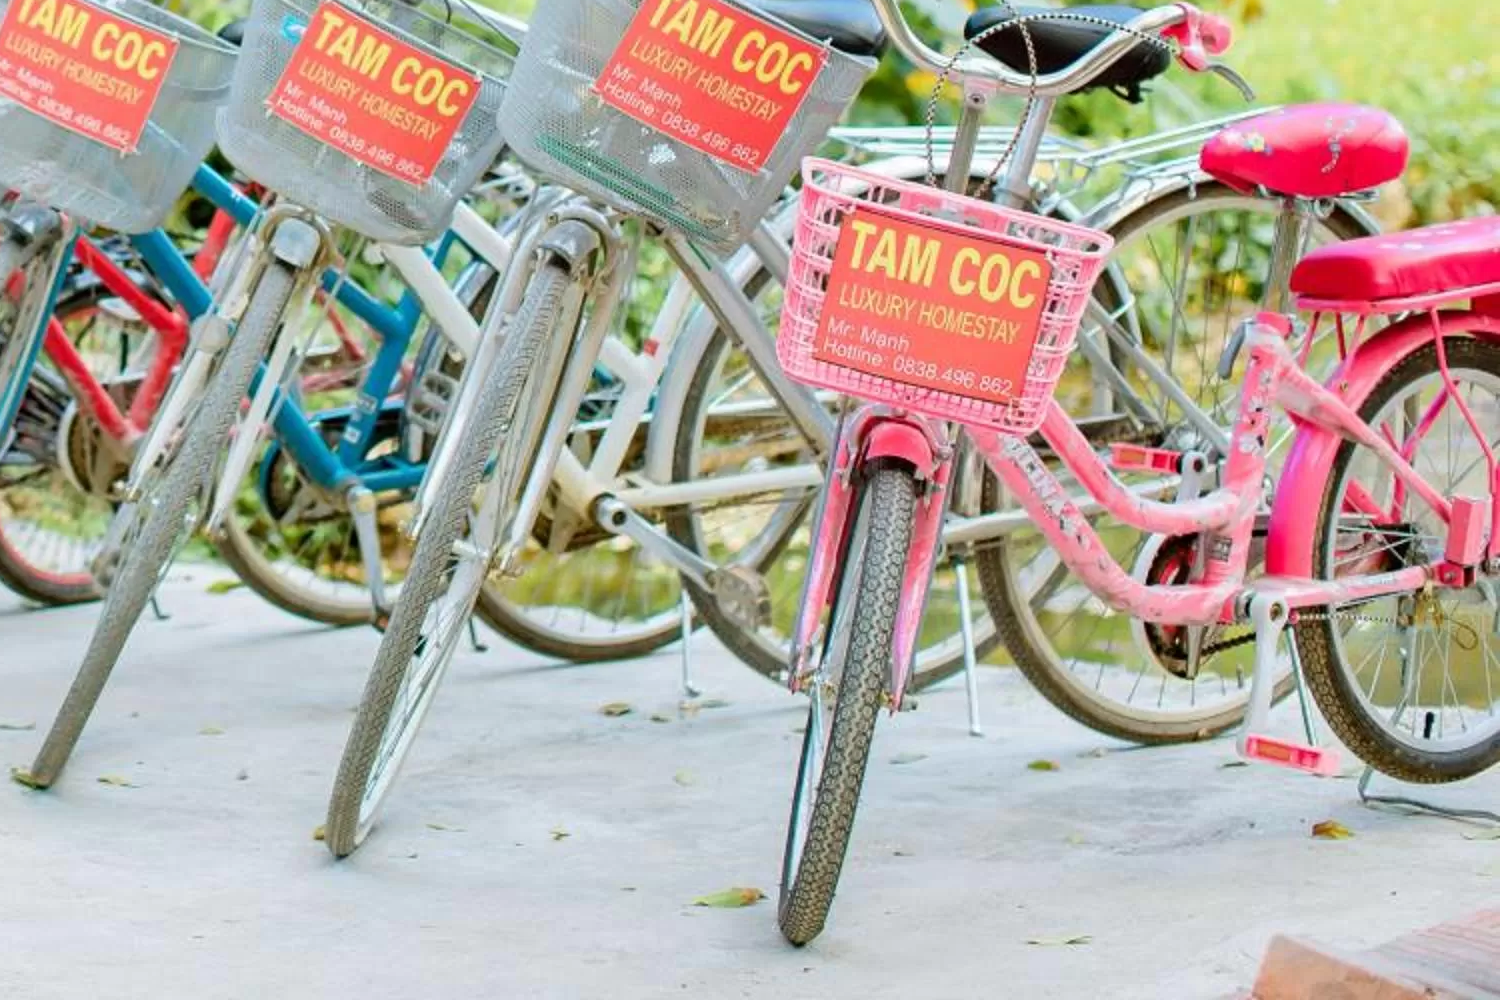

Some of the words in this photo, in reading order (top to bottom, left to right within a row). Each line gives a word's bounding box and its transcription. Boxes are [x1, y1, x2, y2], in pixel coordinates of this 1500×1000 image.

[4, 31, 65, 72] LUXURY
[61, 57, 144, 105] HOMESTAY
[91, 23, 166, 80] COC
[314, 11, 391, 81] TAM
[391, 56, 468, 116] COC
[629, 36, 700, 83] LUXURY
[696, 69, 782, 121] HOMESTAY
[732, 31, 812, 95] COC
[299, 57, 363, 102] LUXURY
[358, 89, 443, 142] HOMESTAY
[849, 220, 942, 288] TAM
[949, 247, 1041, 309] COC
[838, 284, 918, 320] LUXURY
[917, 303, 1021, 345] HOMESTAY
